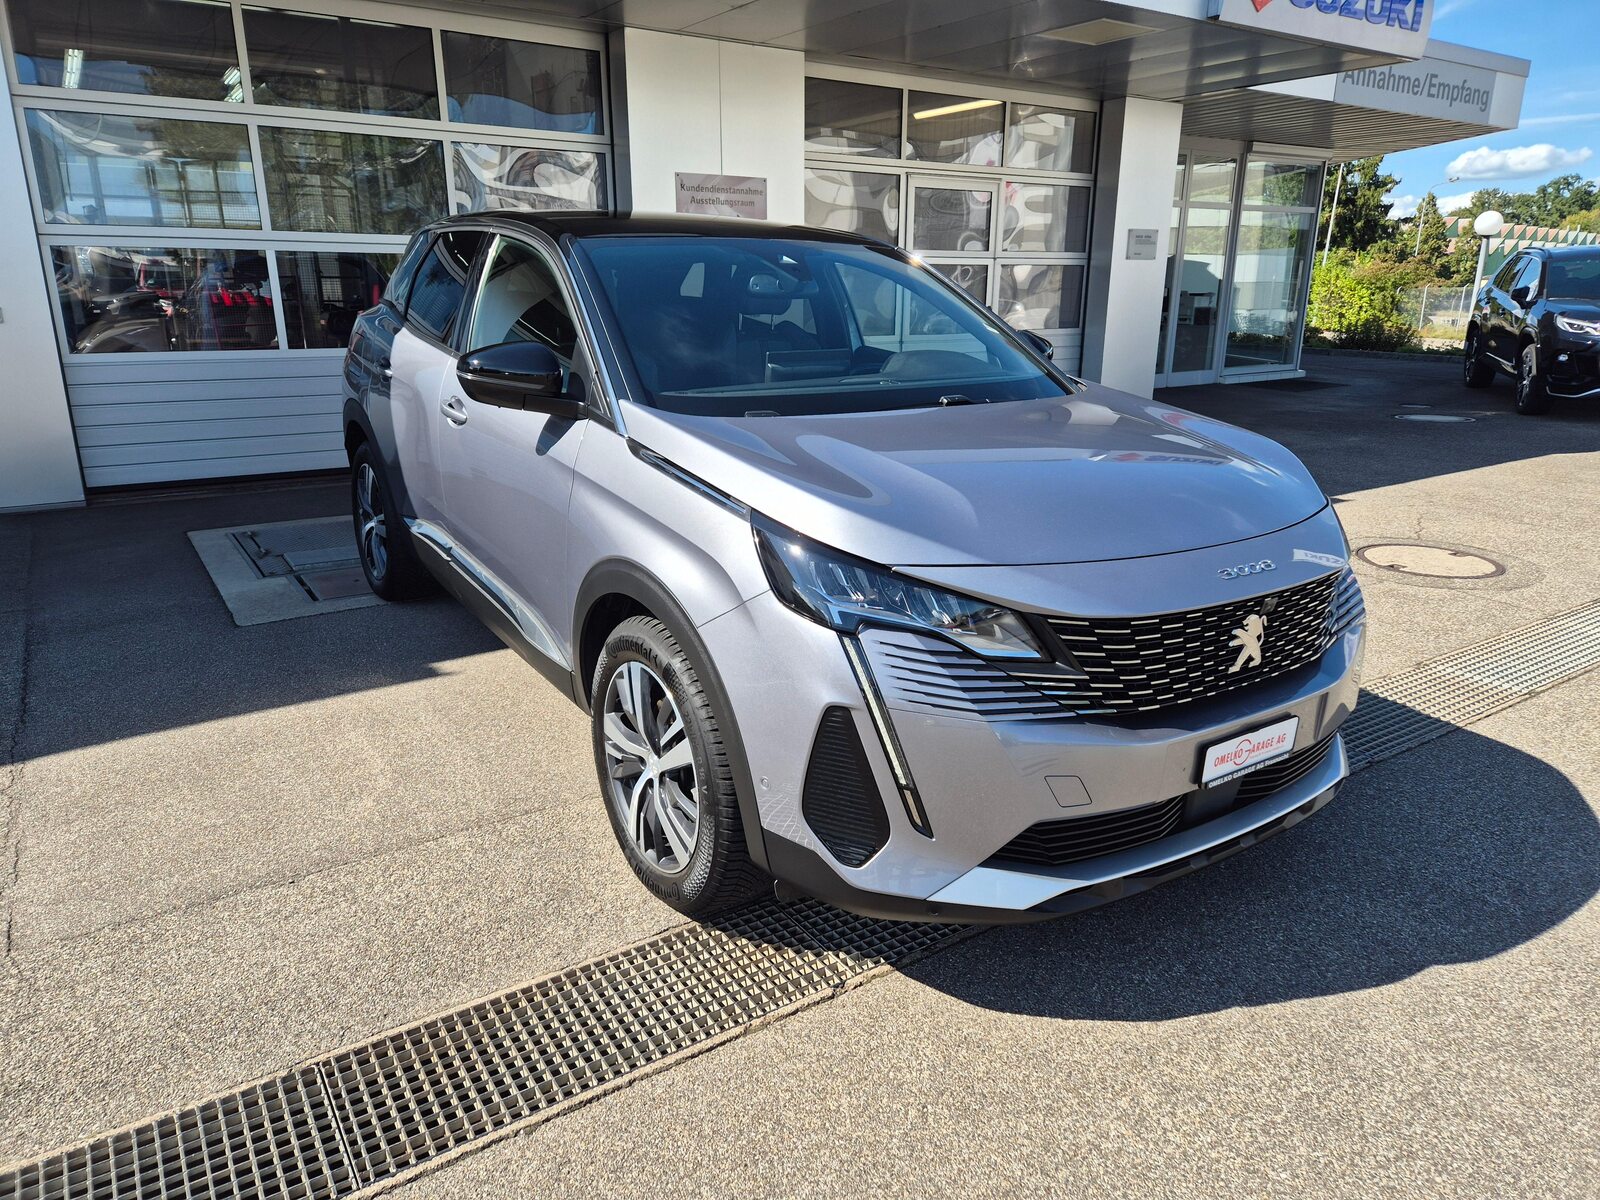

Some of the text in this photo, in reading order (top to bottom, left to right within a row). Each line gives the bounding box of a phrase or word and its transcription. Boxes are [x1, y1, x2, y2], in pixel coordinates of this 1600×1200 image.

[680, 183, 764, 196] Kundendienstannahme
[690, 195, 755, 208] Ausstellungsraum
[1217, 559, 1276, 580] 3008
[605, 636, 653, 663] Continental
[1213, 748, 1244, 768] OMELKO
[1276, 733, 1287, 745] AG
[1208, 773, 1233, 788] OMELKO
[1232, 765, 1256, 779] GARAGE
[1255, 761, 1265, 770] AG
